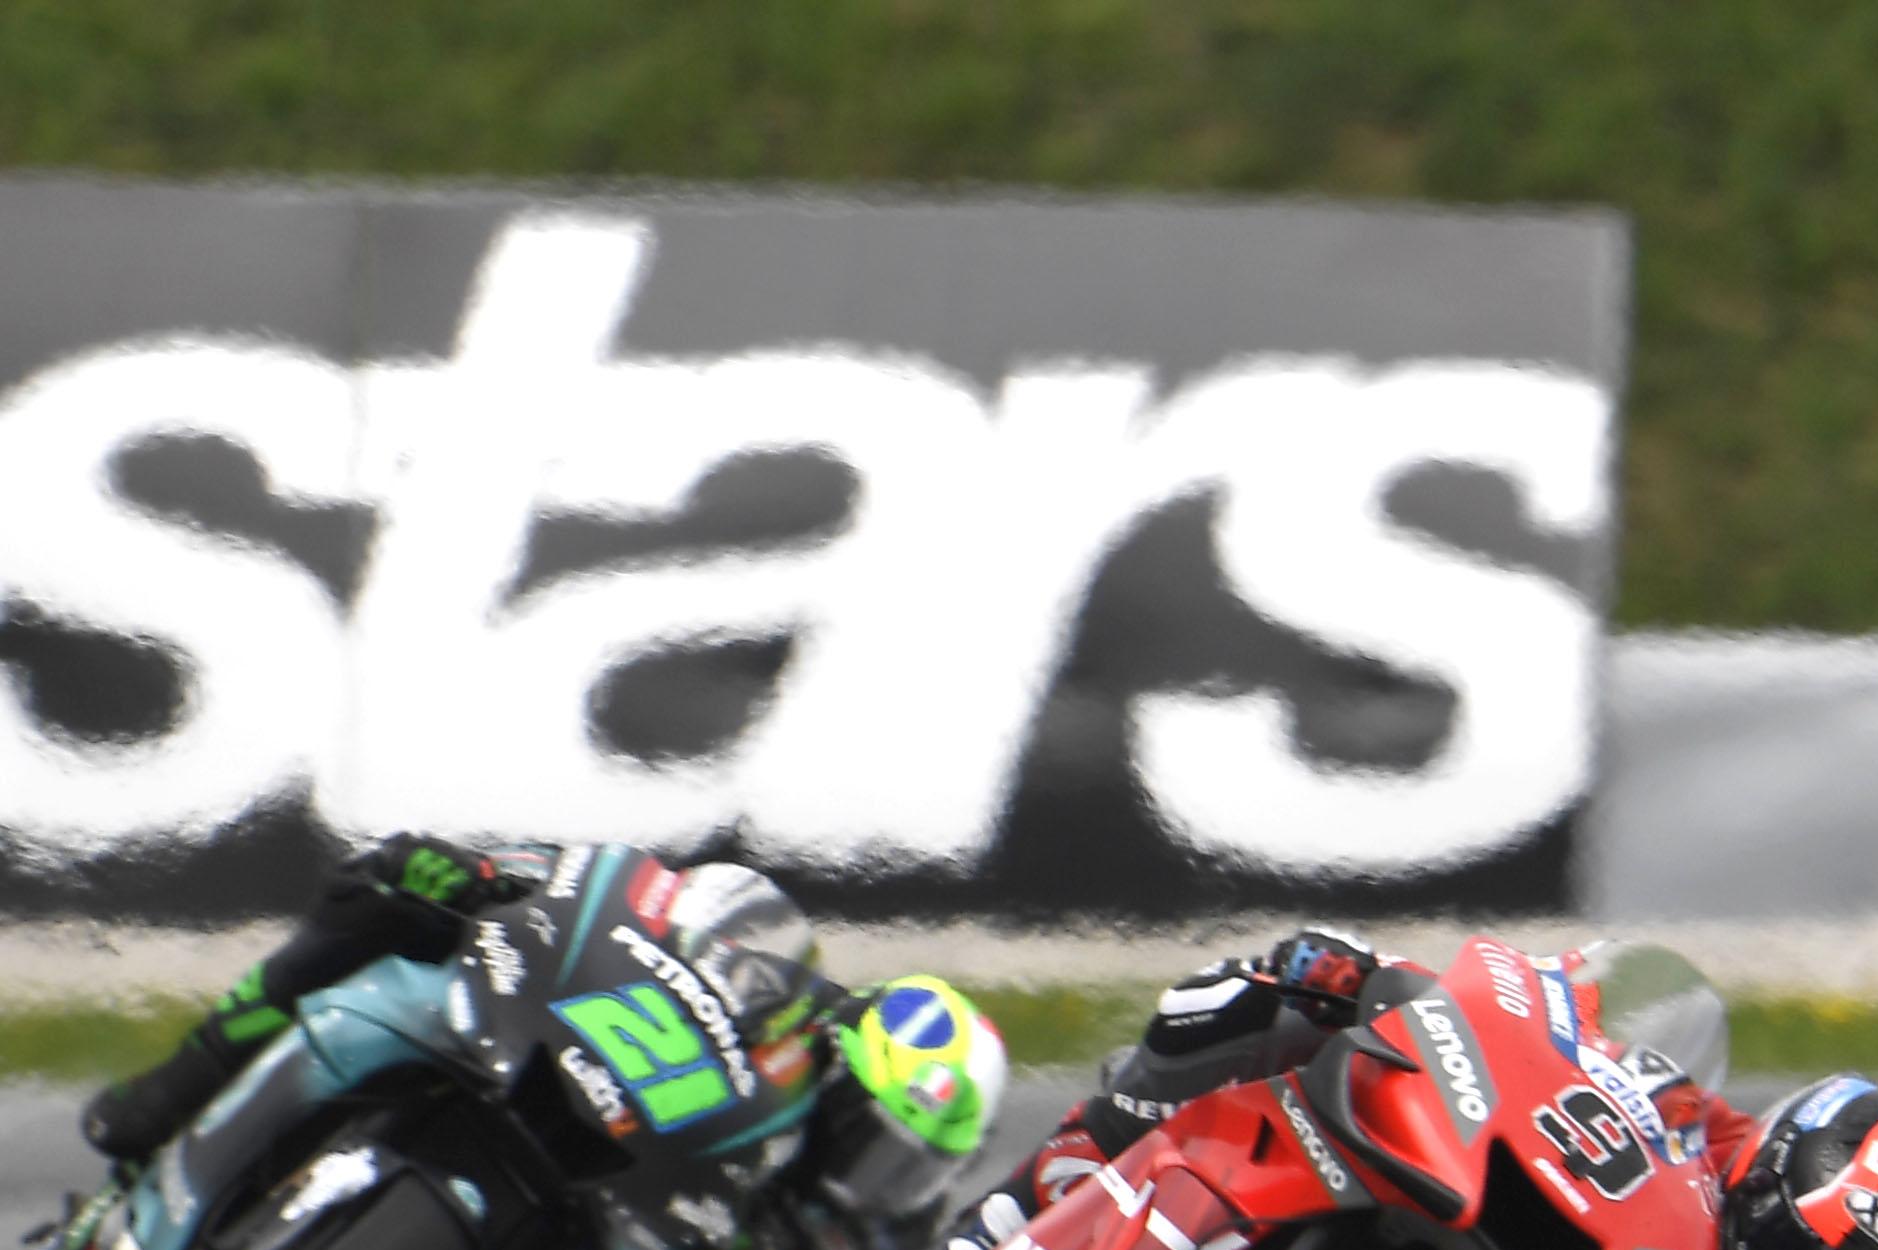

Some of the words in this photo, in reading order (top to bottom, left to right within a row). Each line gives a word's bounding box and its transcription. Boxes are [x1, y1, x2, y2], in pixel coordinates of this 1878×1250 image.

[0, 208, 1615, 880] stars
[552, 984, 732, 1128] 21
[1411, 998, 1490, 1122] Lenovo
[1281, 1088, 1348, 1192] Lenovo
[1532, 1084, 1655, 1201] 9
